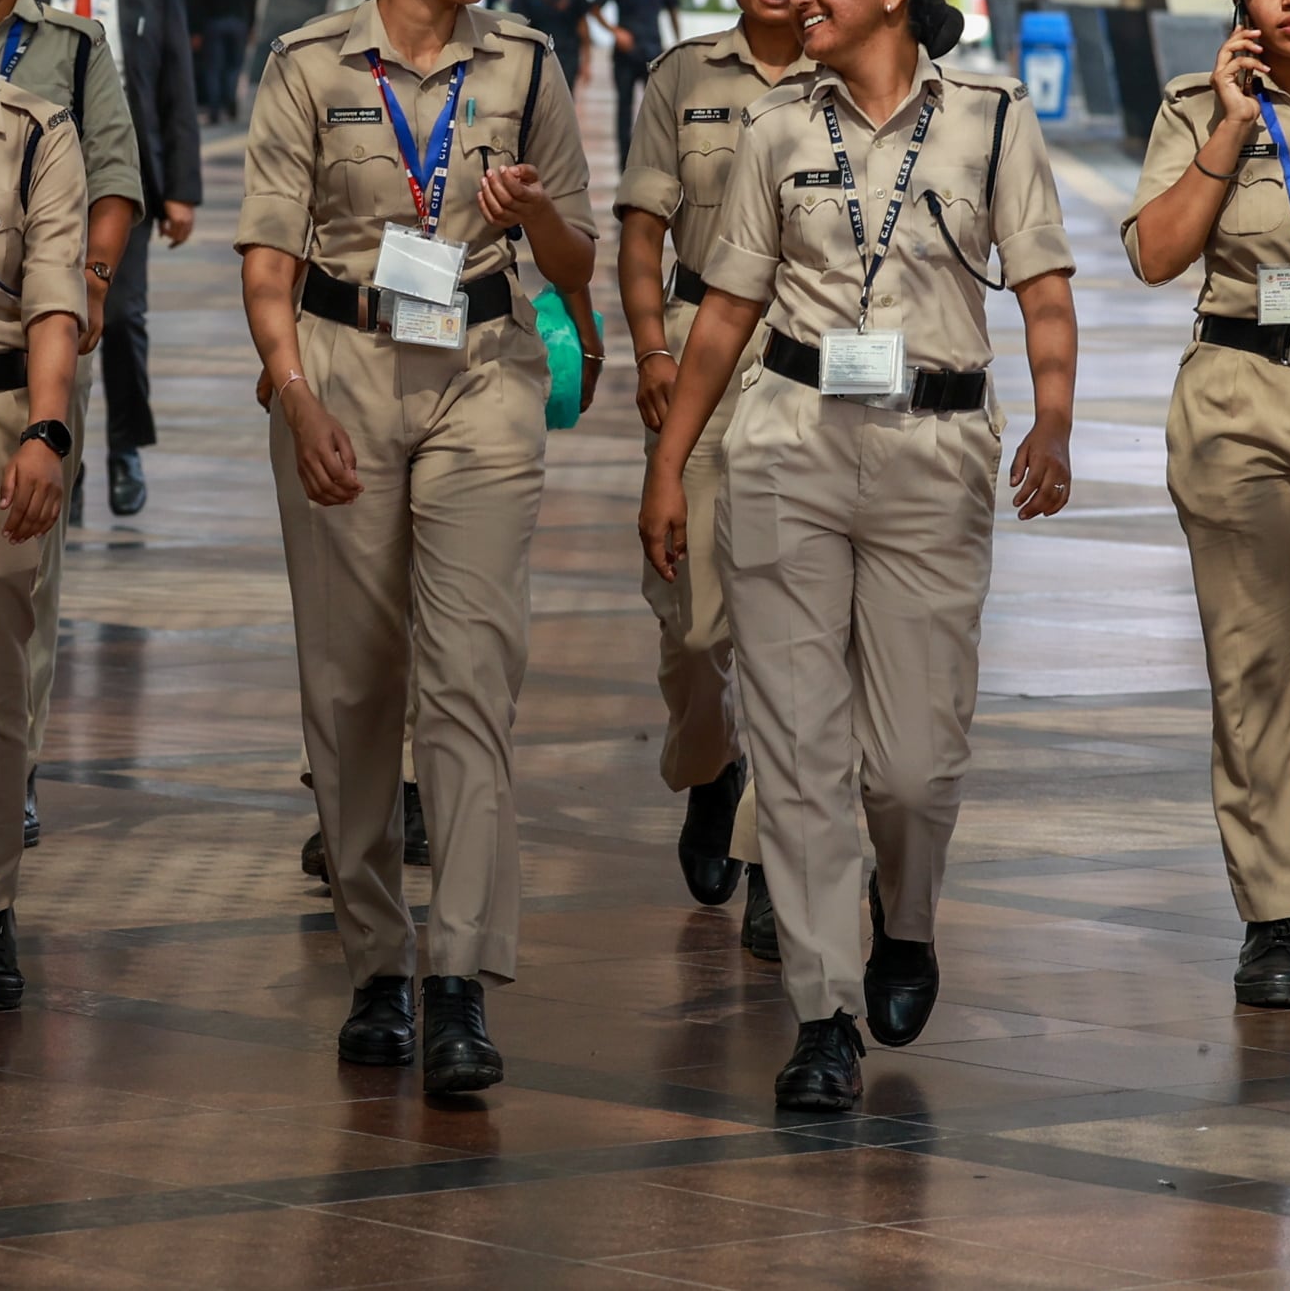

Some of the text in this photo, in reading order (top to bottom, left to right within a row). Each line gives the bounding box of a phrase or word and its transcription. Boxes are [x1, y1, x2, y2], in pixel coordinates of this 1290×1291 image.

[827, 111, 840, 138] C.I.S.F
[914, 109, 930, 137] C.I.S.F
[897, 155, 913, 185] C.I.S.F
[431, 184, 441, 209] CISF
[880, 206, 897, 238] C.I.S.F
